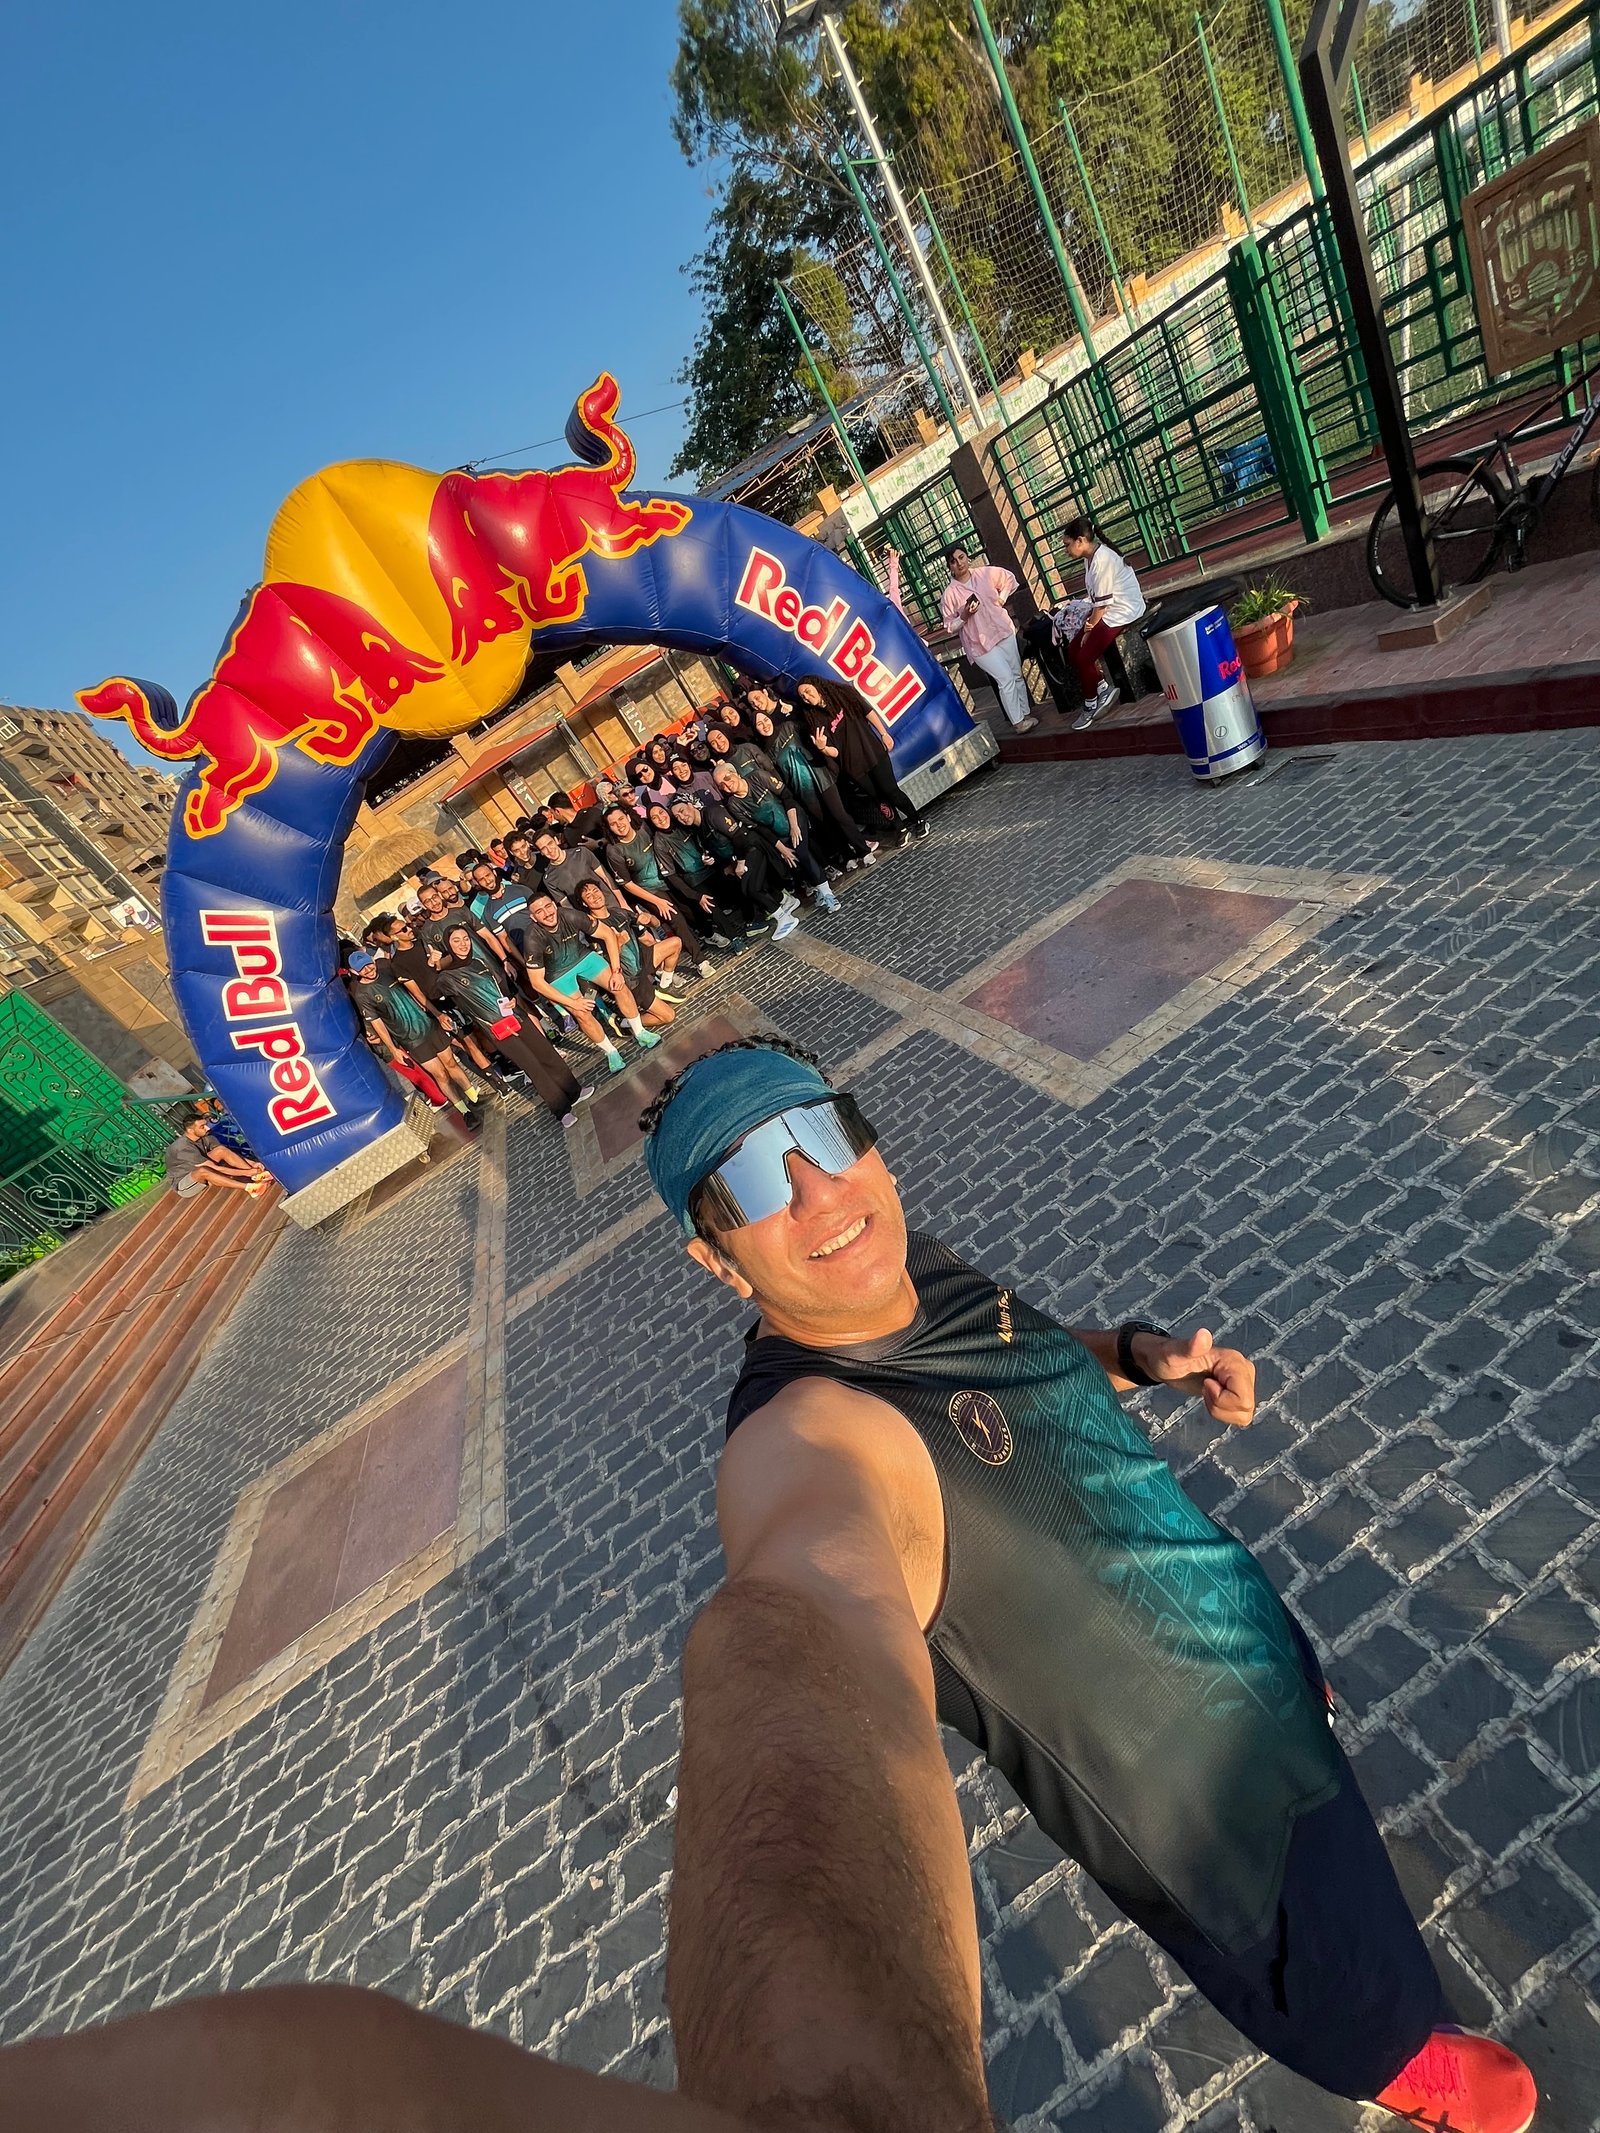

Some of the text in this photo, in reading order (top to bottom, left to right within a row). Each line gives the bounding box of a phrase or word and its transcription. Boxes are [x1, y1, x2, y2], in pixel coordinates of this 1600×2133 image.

[737, 548, 925, 725] Red Bull
[634, 719, 646, 733] 2
[524, 793, 535, 805] 1
[202, 911, 335, 1134] Red Bull
